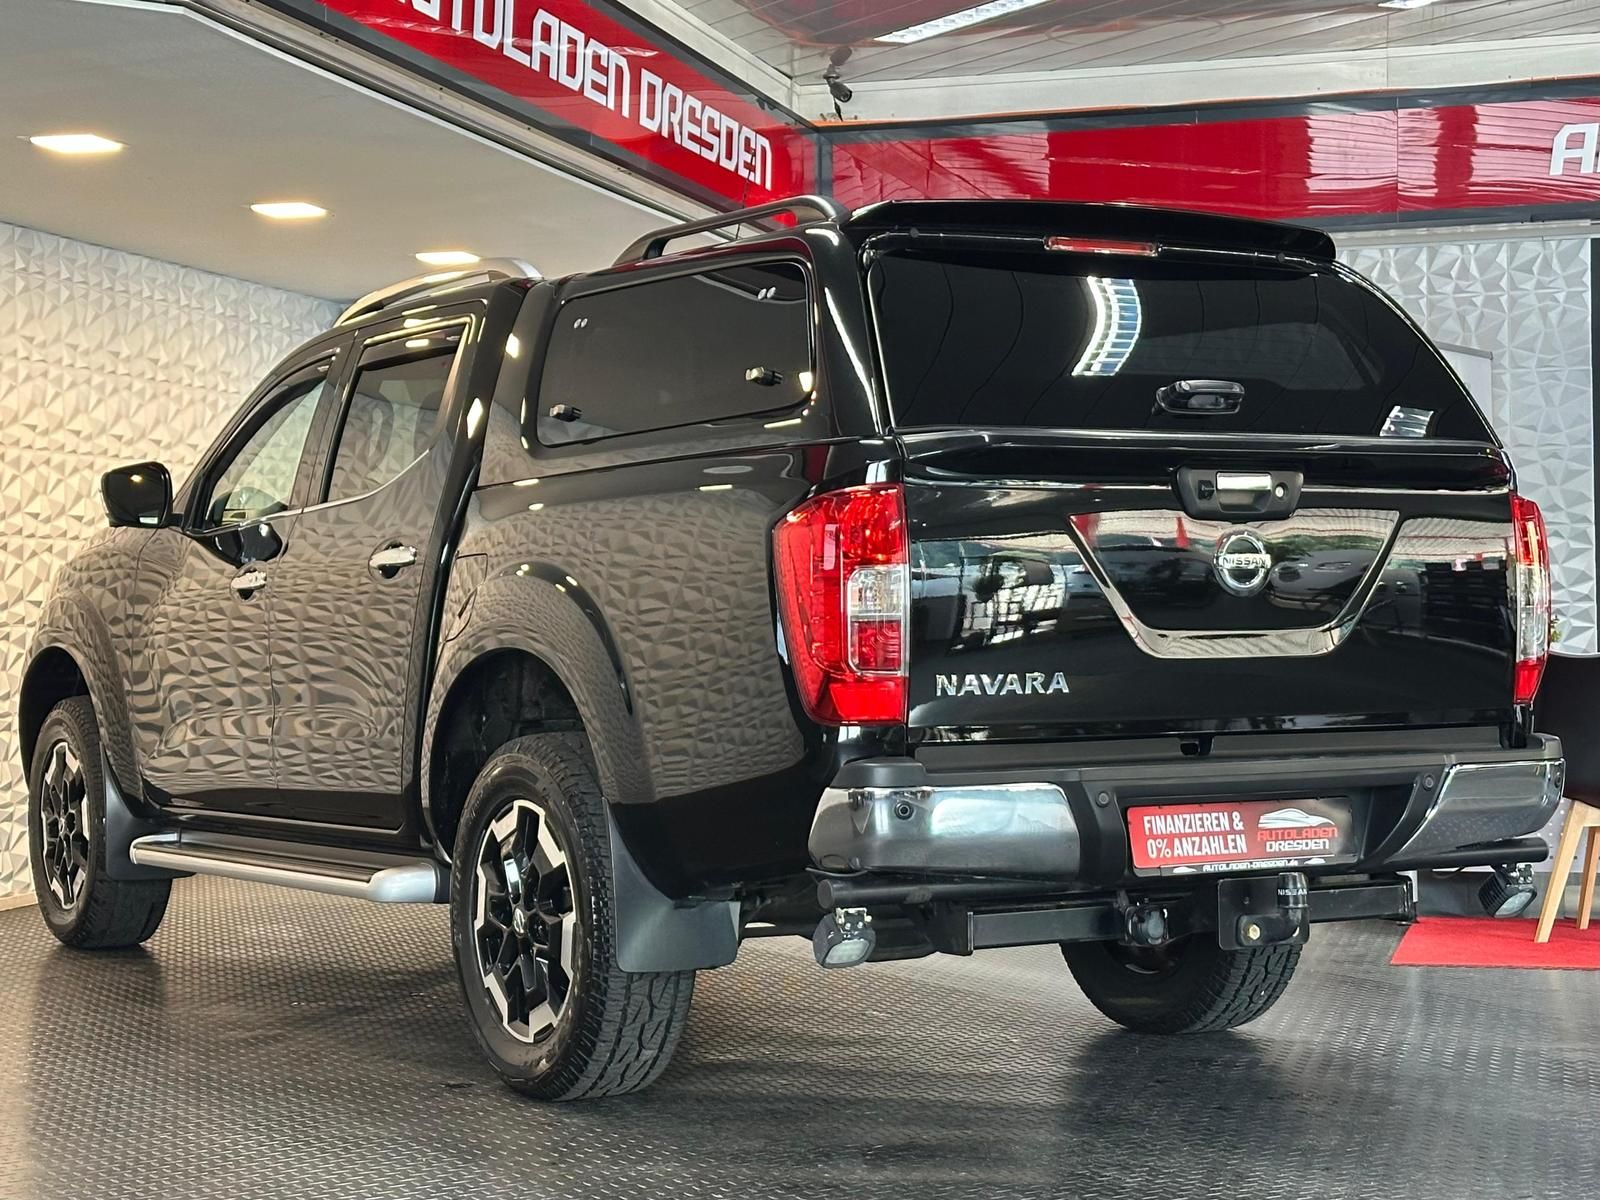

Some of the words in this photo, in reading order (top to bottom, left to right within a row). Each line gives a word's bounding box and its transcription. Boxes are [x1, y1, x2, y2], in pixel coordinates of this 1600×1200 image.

[640, 68, 772, 190] DRESDEN
[1550, 122, 1600, 176] A
[1222, 556, 1266, 566] NISSAN
[935, 672, 1069, 696] NAVARA
[1143, 812, 1229, 835] FINANZIEREN
[1232, 811, 1244, 831] &
[1257, 826, 1338, 841] AUTOLADEN
[1147, 838, 1171, 858] 0%
[1173, 834, 1247, 857] ANZAHLEN
[1265, 839, 1329, 852] DRESDEN
[1277, 888, 1308, 896] NISSAN
